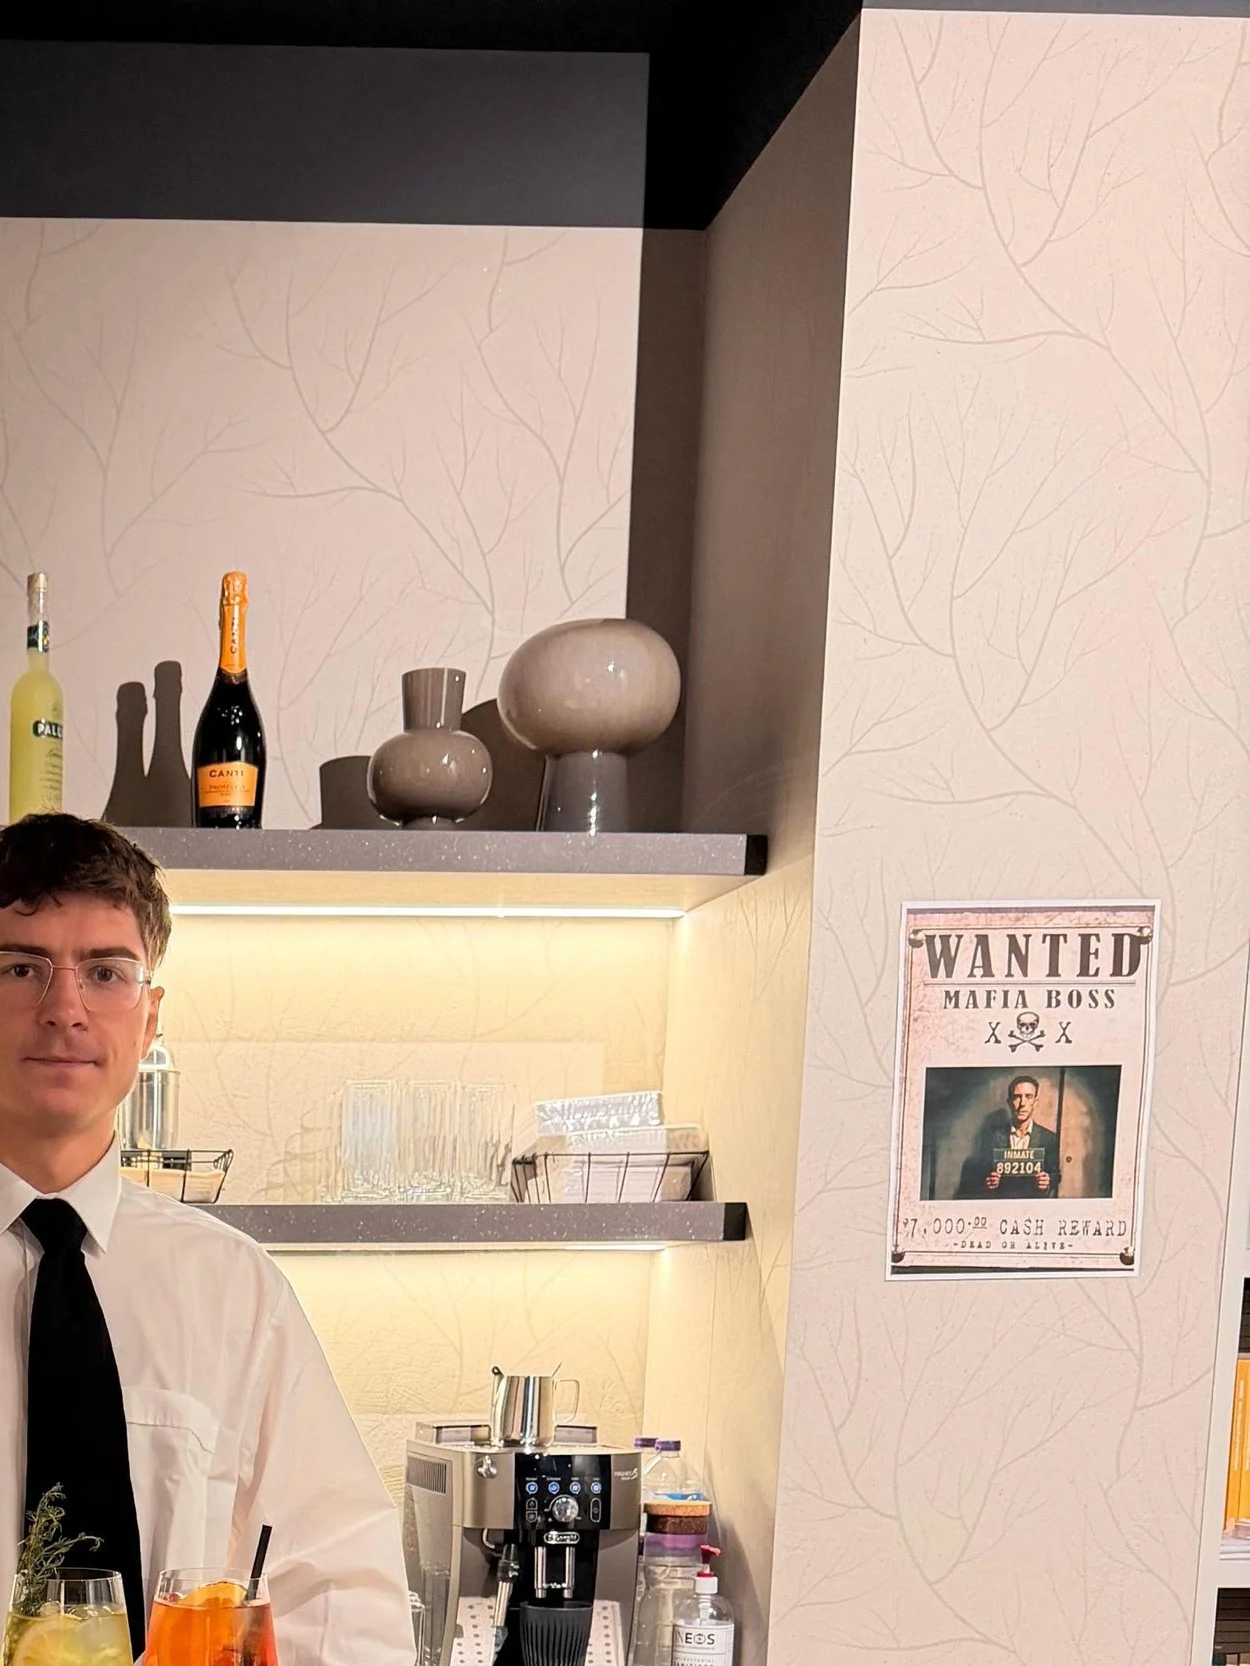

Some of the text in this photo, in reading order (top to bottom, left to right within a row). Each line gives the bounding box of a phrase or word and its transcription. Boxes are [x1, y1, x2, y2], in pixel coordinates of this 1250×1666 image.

[209, 769, 244, 778] CANTI
[924, 933, 1141, 979] WANTED
[942, 988, 1116, 1010] MAFIA BOSS
[1004, 1150, 1035, 1159] INMATE
[996, 1161, 1042, 1174] 892104
[999, 1217, 1044, 1236] CASH
[1057, 1219, 1127, 1237] REWARD
[1001, 1241, 1016, 1249] OR
[674, 1629, 715, 1645] NEOS
